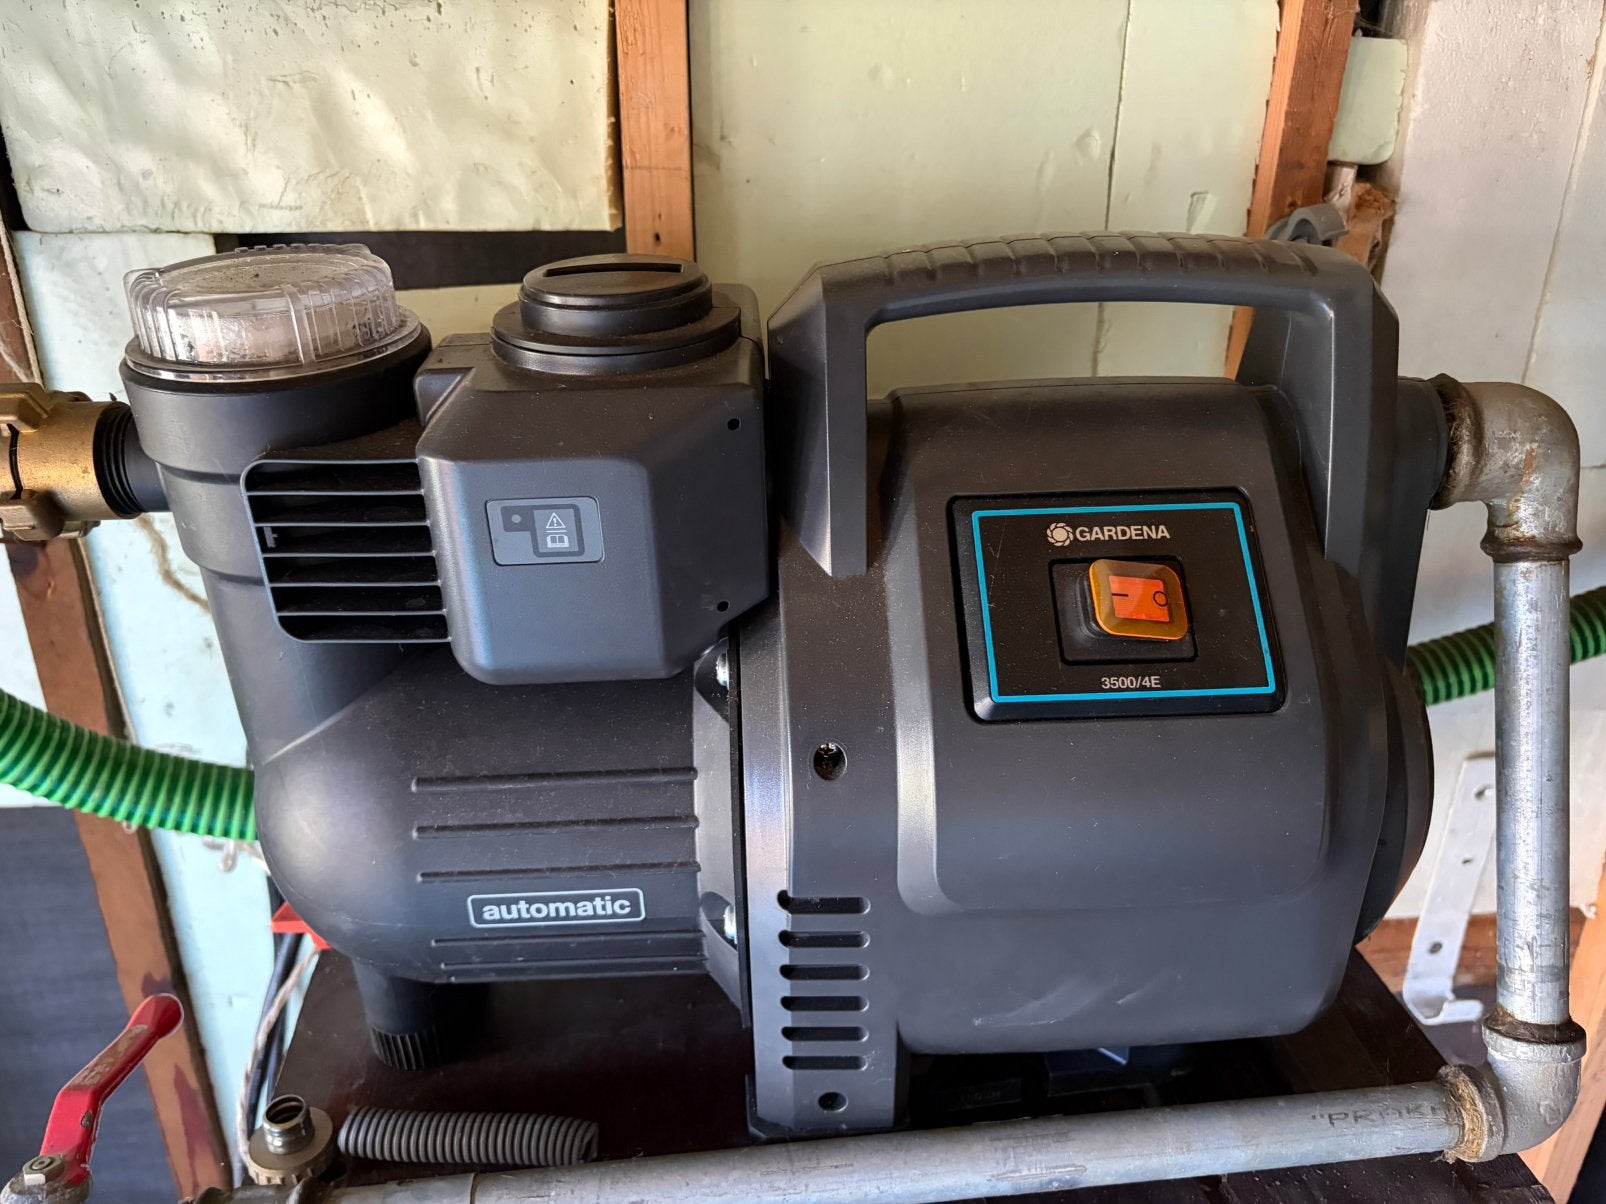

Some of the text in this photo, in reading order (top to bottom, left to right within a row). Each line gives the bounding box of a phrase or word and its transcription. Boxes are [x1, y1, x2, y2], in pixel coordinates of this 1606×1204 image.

[1075, 525, 1171, 541] GARDENA
[1101, 675, 1162, 689] 3500/4E
[482, 895, 631, 921] automatic
